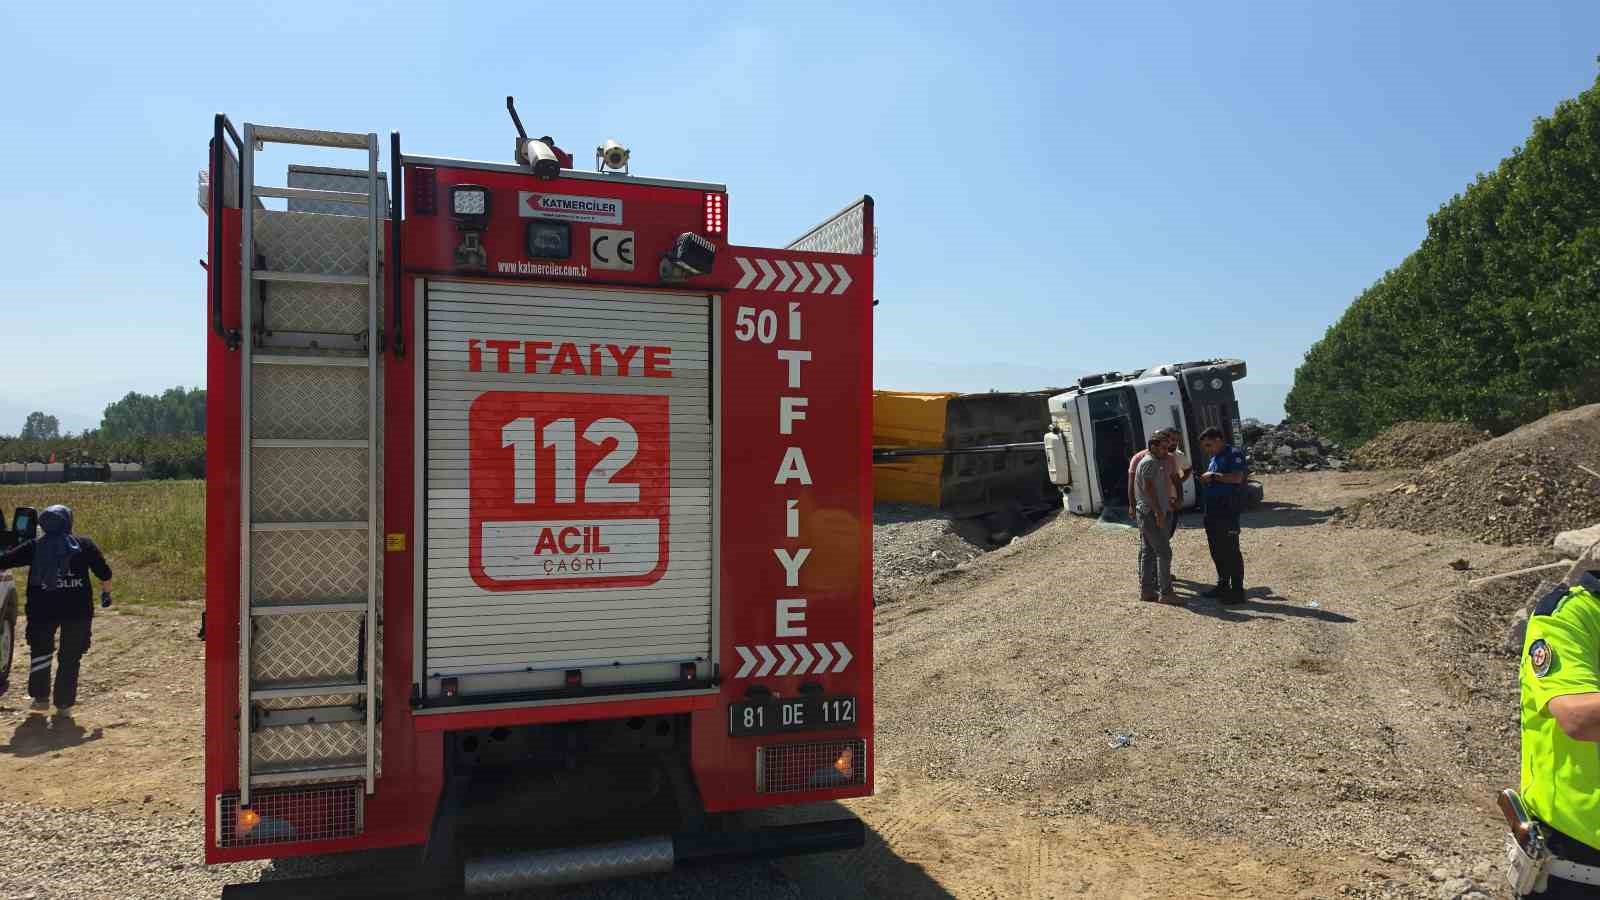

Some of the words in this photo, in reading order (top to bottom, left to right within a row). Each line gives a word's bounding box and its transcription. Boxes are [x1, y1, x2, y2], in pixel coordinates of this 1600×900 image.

[543, 198, 615, 212] KATMERCİLER
[593, 235, 633, 264] CE
[735, 306, 778, 344] 50
[468, 339, 672, 378] İTFAİYE
[502, 417, 640, 504] 112
[534, 526, 610, 555] ACİL
[543, 558, 602, 575] ÇAĞRI
[743, 706, 764, 728] 81
[782, 703, 804, 726] DE
[822, 700, 852, 722] 112
